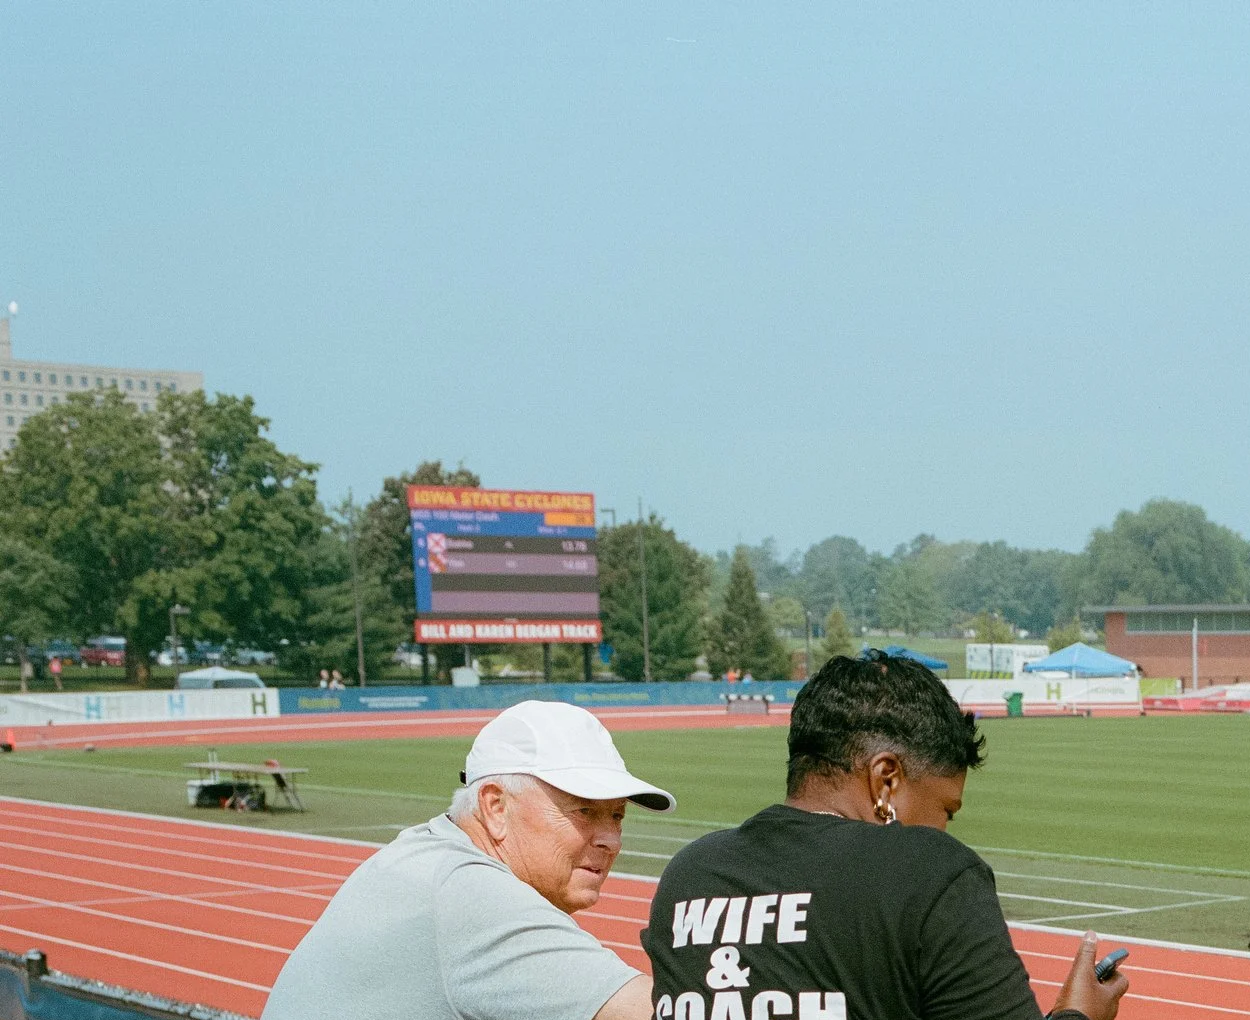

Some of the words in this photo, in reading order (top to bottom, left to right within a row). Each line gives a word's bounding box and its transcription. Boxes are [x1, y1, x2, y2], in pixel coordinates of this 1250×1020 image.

[414, 490, 456, 505] IOWA
[461, 491, 512, 507] STATE
[514, 493, 592, 510] CYCLONES
[420, 623, 446, 639] BILL
[448, 623, 474, 639] AND
[475, 623, 514, 639] KAREN
[562, 623, 597, 639] TRACK
[1046, 682, 1062, 700] H
[251, 693, 268, 715] H
[672, 892, 812, 949] WIFE
[706, 945, 750, 989] &
